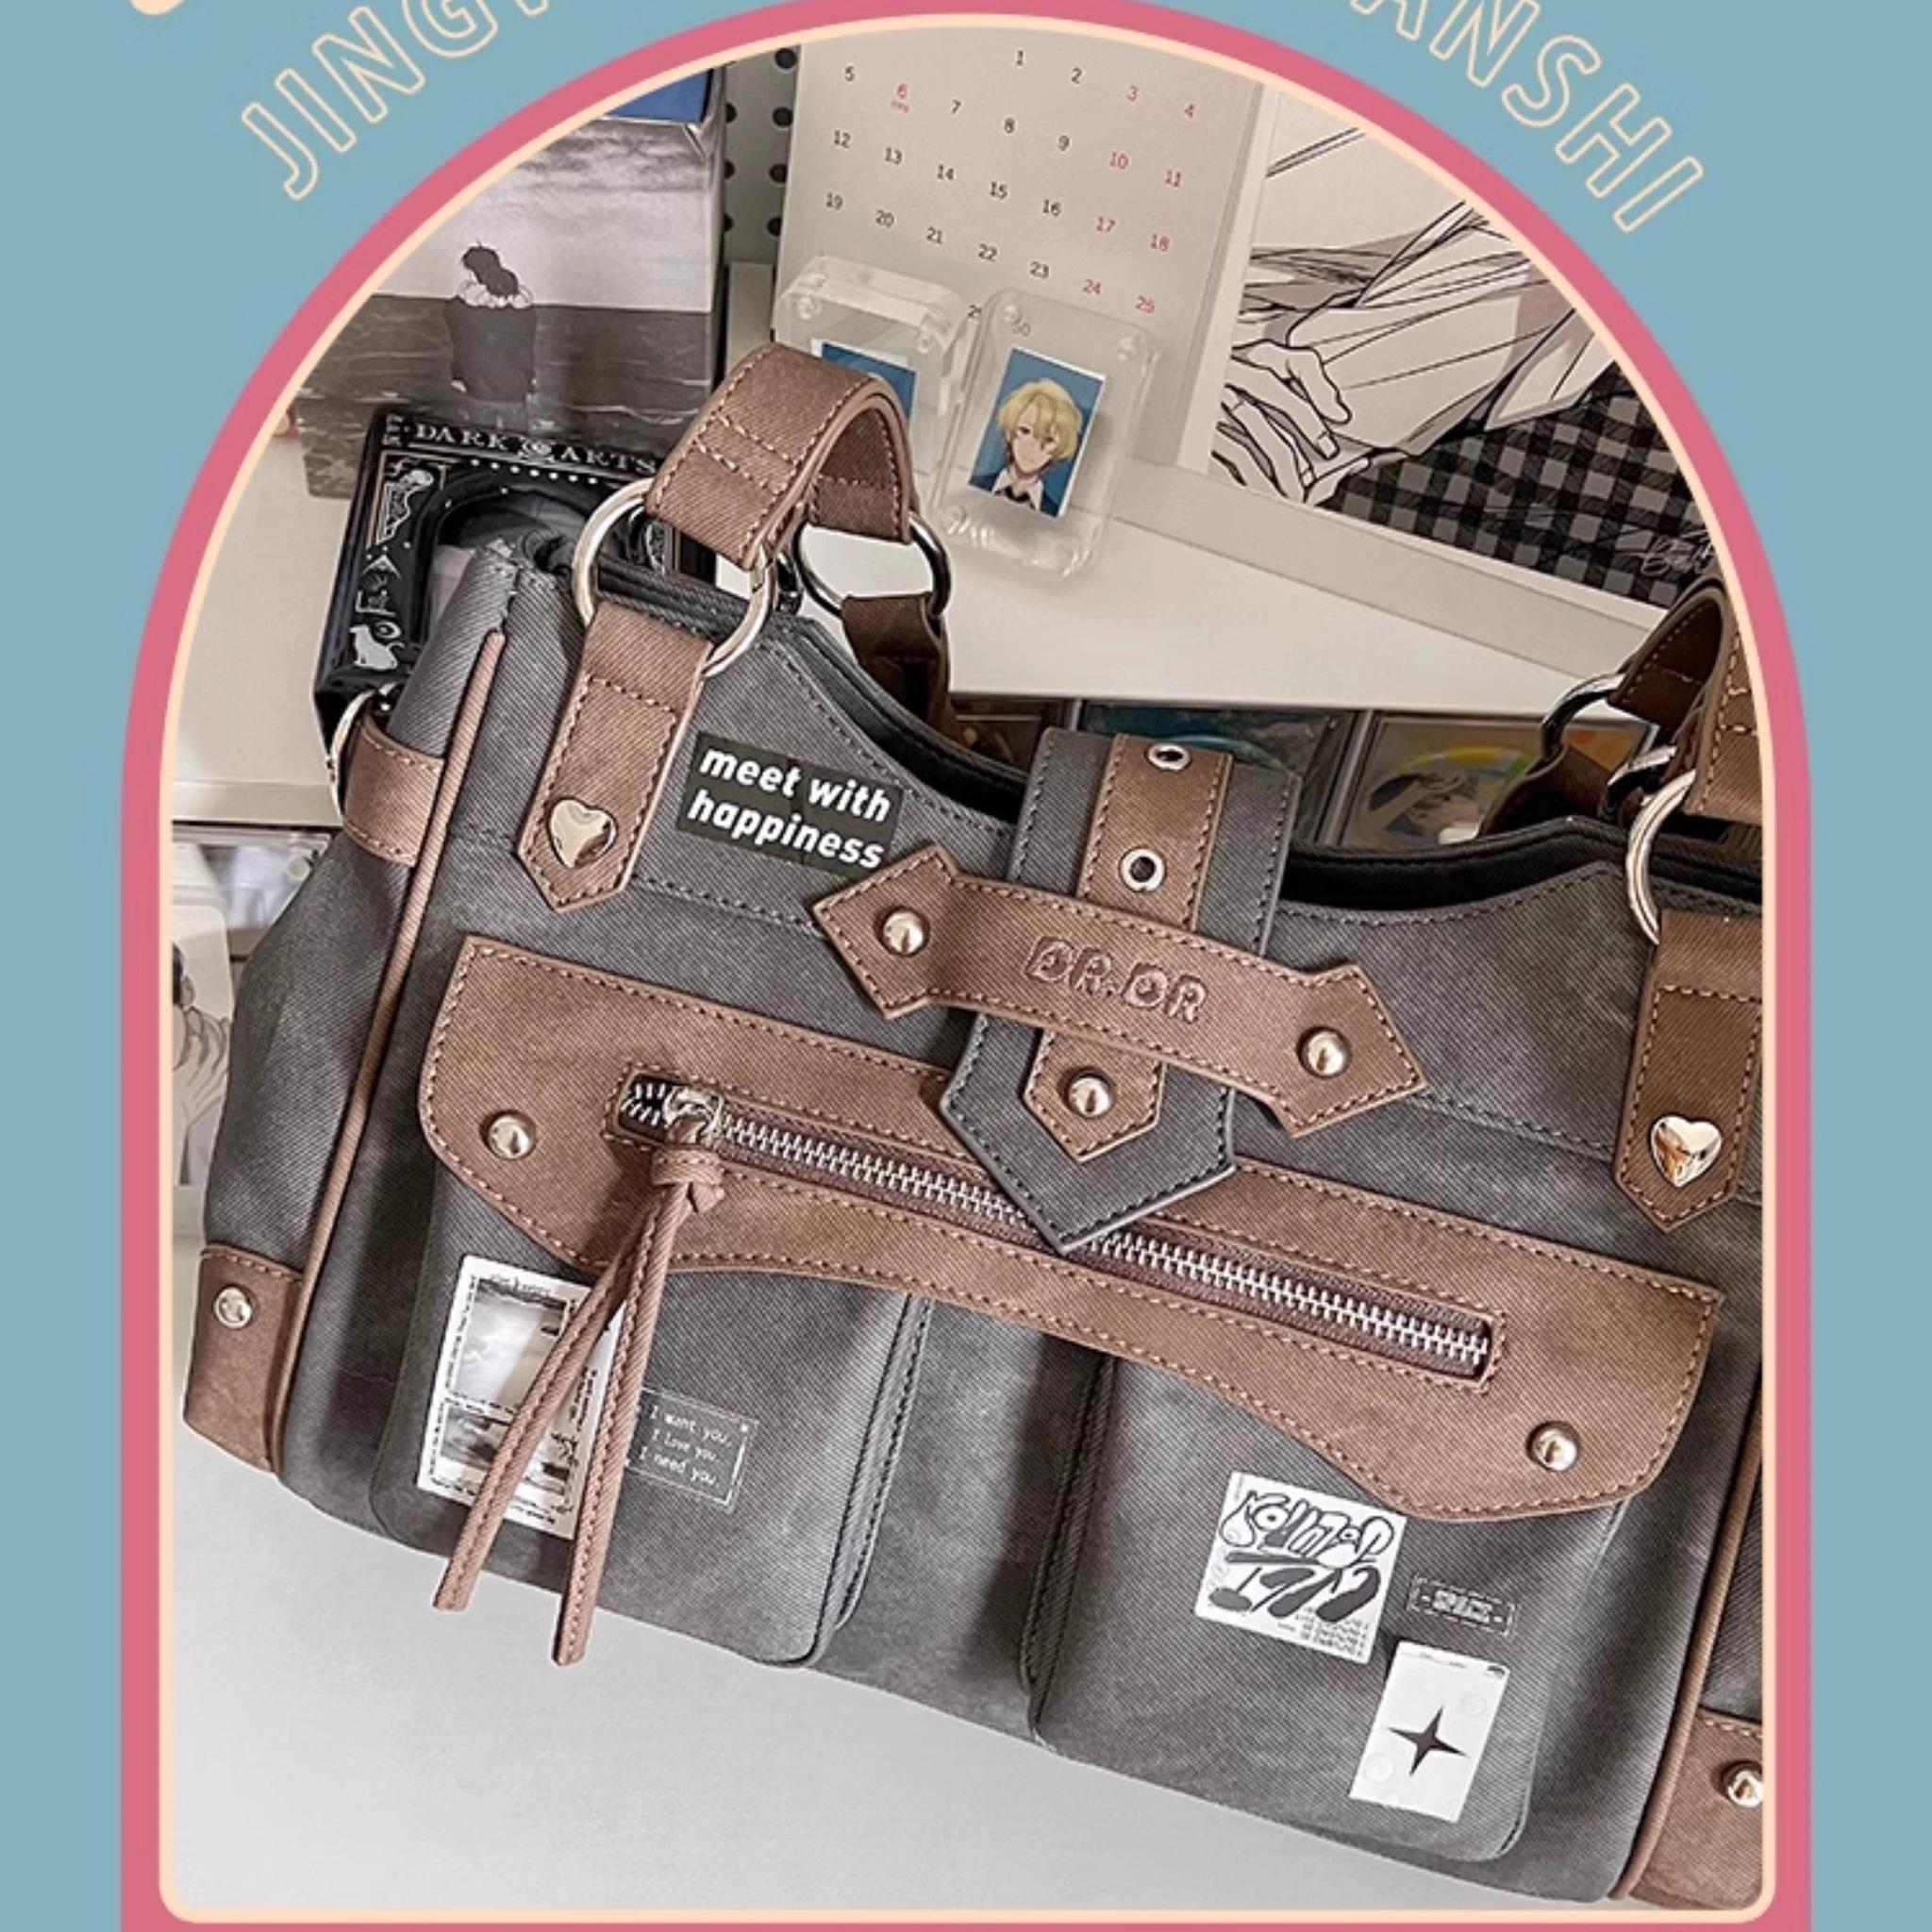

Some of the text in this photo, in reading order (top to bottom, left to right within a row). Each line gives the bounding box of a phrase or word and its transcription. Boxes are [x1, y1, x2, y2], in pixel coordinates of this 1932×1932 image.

[1016, 49, 1195, 118] 1 2 3 4
[844, 65, 1182, 188] 5 6 7 8 9 10 11
[833, 129, 1170, 252] 12 13 14 15 16 17 18
[825, 192, 1156, 314] 19 20 21 22 23 24 25
[416, 425, 509, 451] DARK
[560, 445, 657, 474] ARTS
[699, 748, 891, 823] meet with
[687, 789, 885, 869] happiness
[652, 1451, 688, 1474] need
